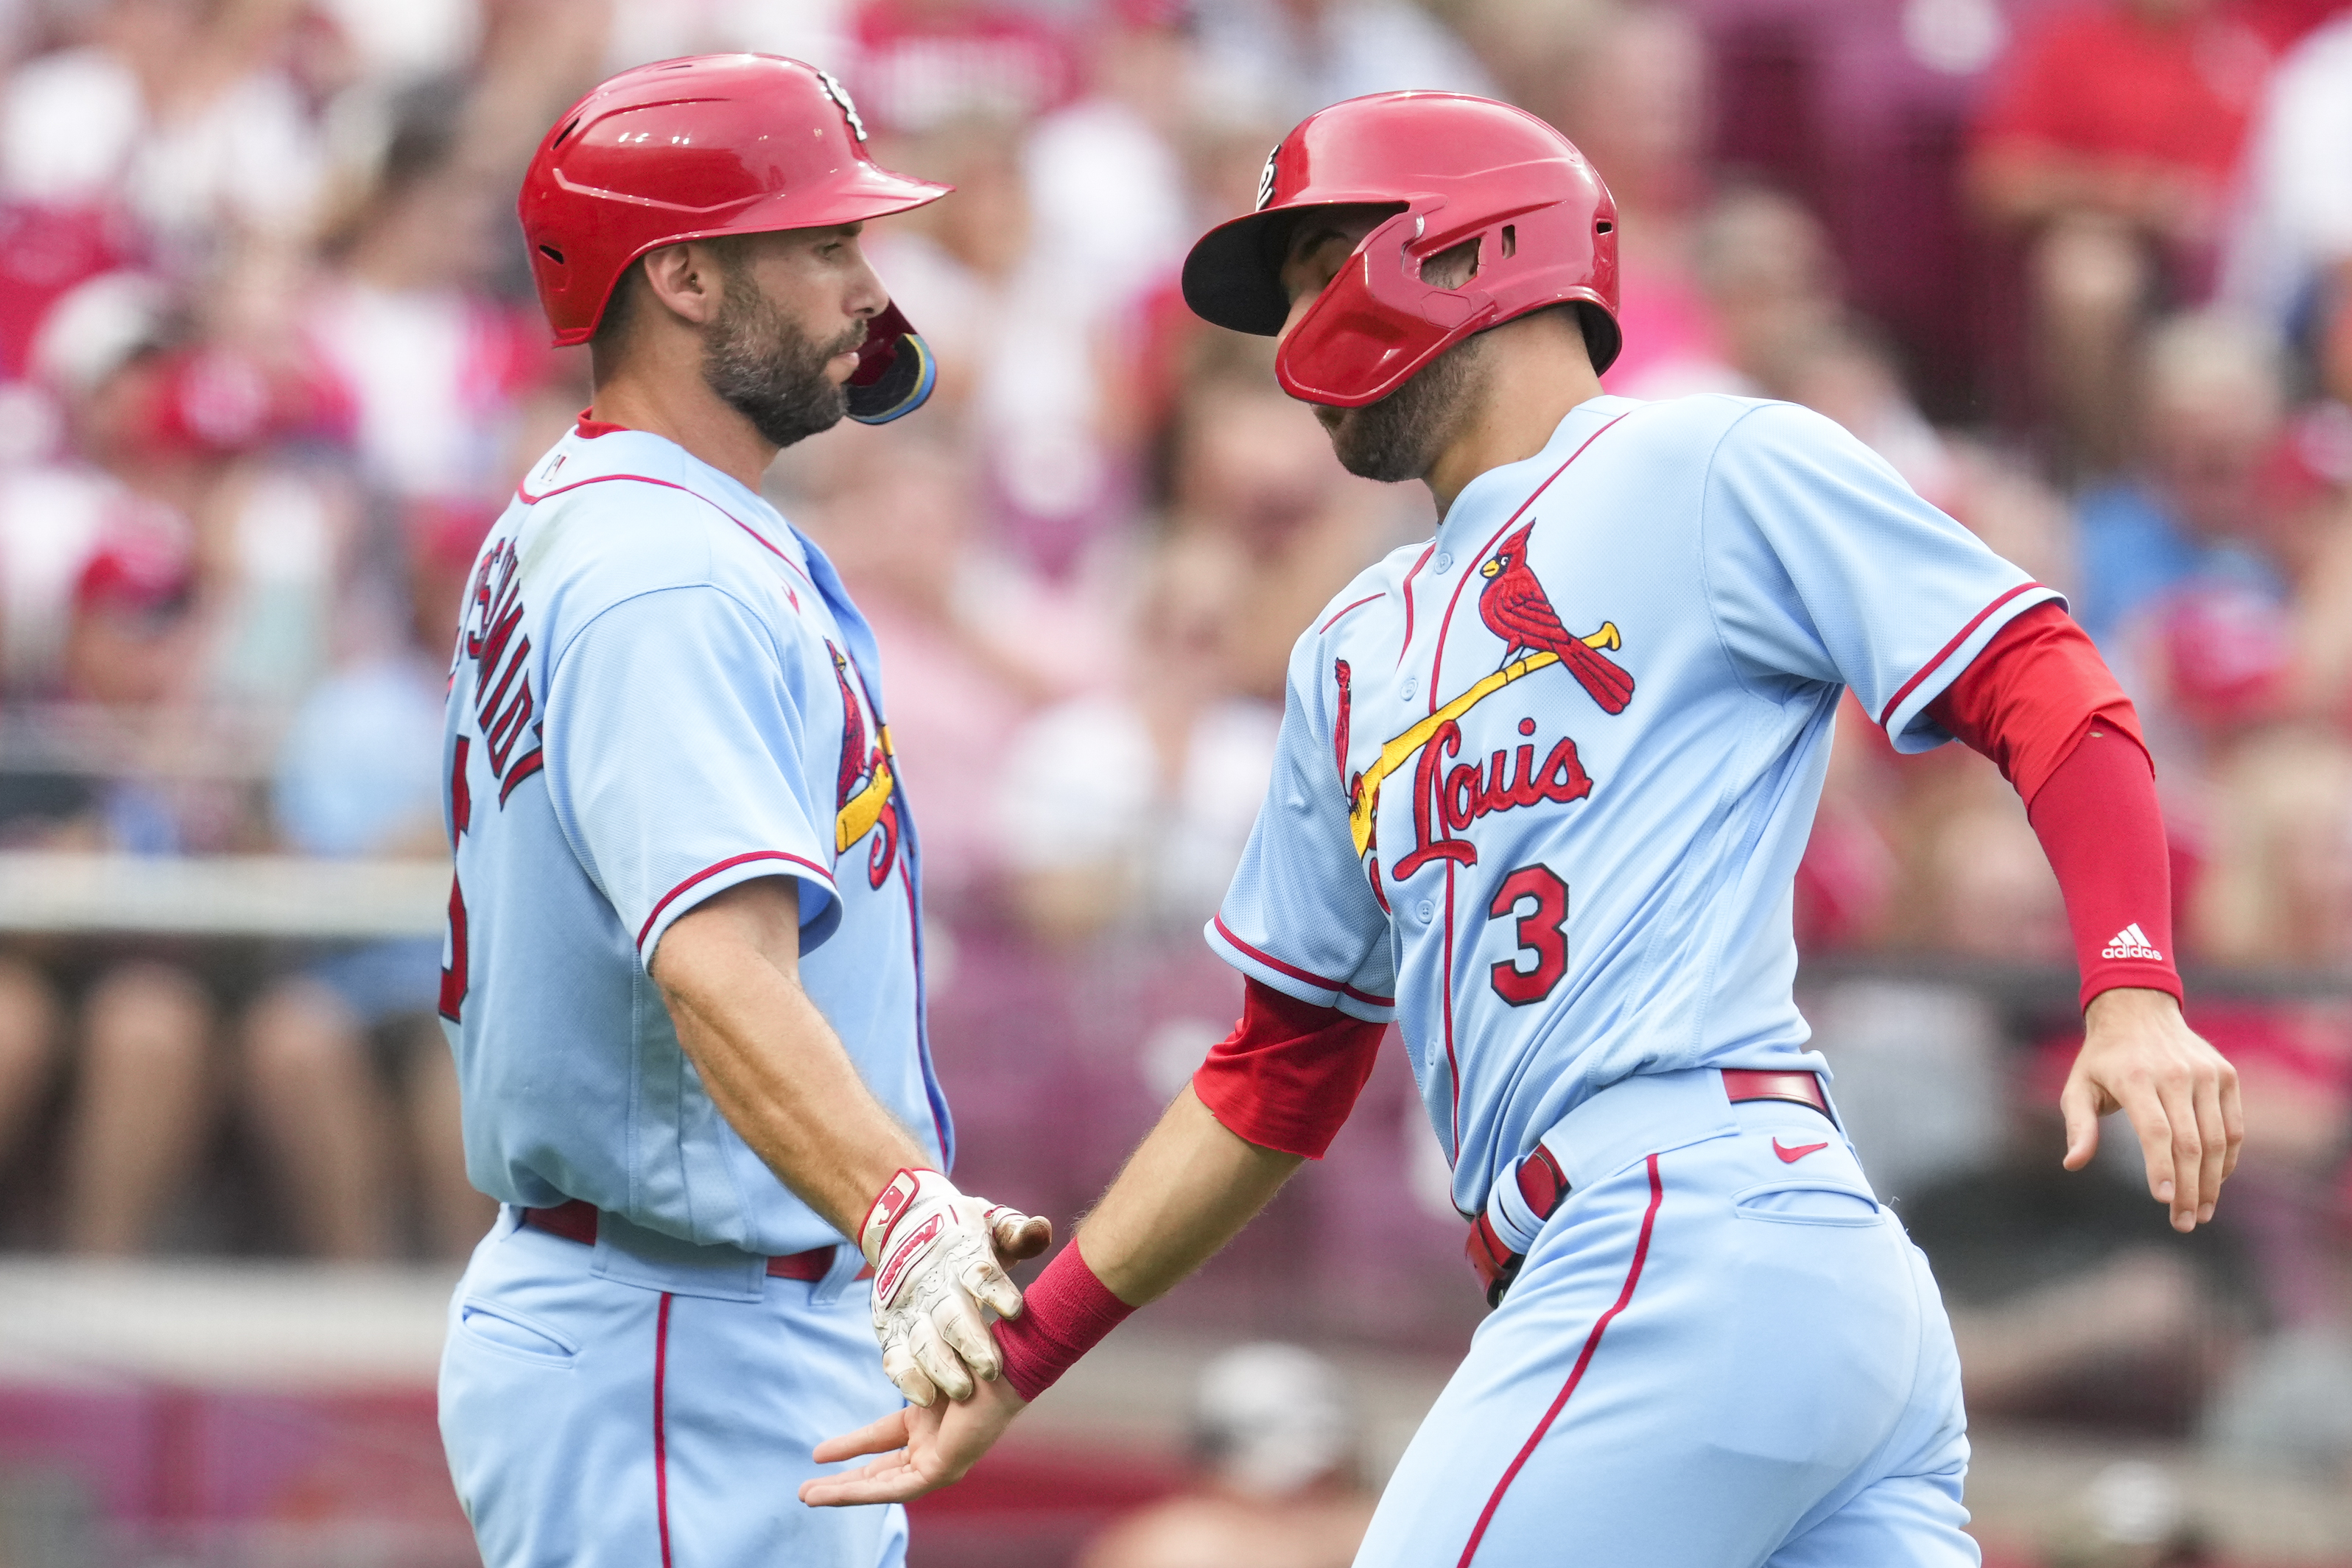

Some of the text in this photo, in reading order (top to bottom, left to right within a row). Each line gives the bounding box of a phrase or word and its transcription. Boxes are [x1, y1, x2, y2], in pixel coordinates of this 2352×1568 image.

[1392, 719, 1593, 882] Louis
[1489, 862, 1569, 1008] 3
[2102, 943, 2163, 961] adidas
